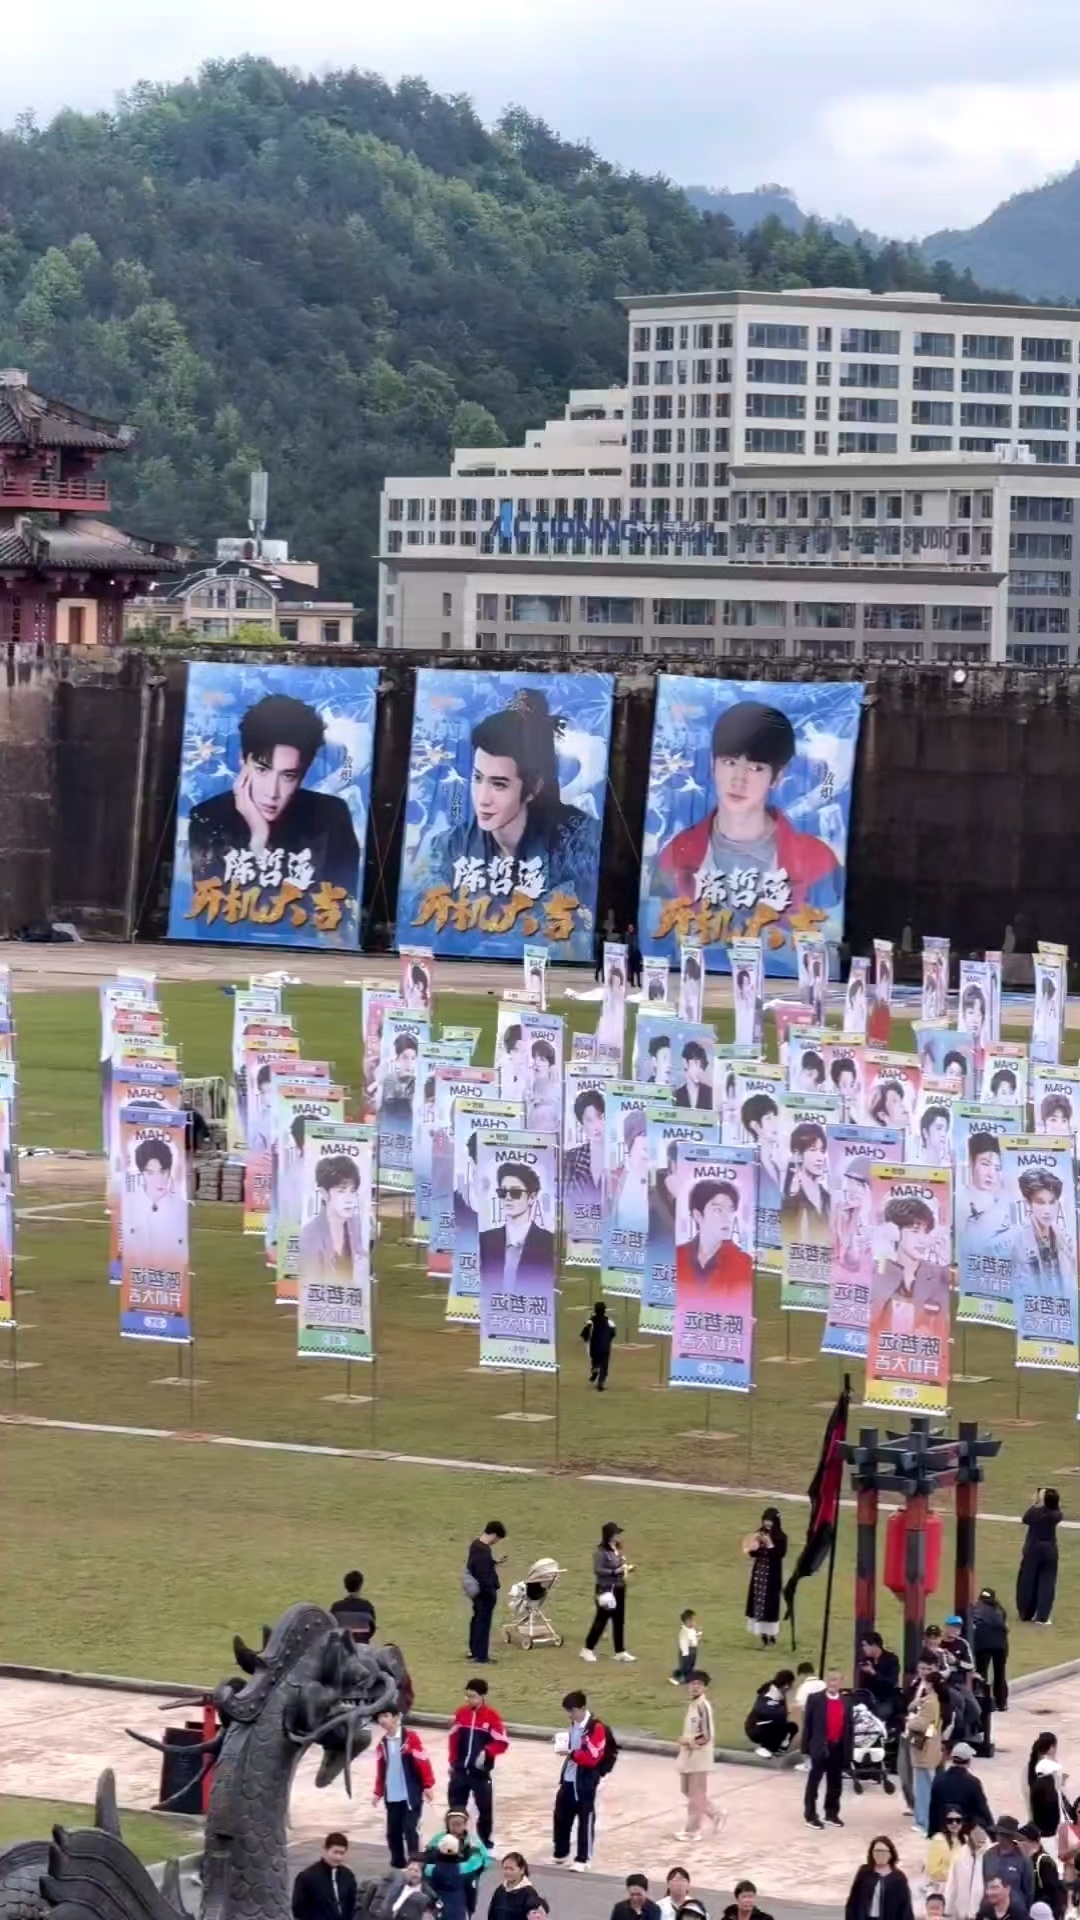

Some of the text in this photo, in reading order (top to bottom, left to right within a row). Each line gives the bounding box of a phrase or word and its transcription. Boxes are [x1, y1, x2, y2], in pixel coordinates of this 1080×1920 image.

[223, 848, 316, 891] 陈哲远
[453, 855, 548, 900] 陈哲远
[693, 867, 793, 912] 陈哲远
[183, 876, 348, 931] 开机大吉
[410, 884, 580, 940] 开机大吉
